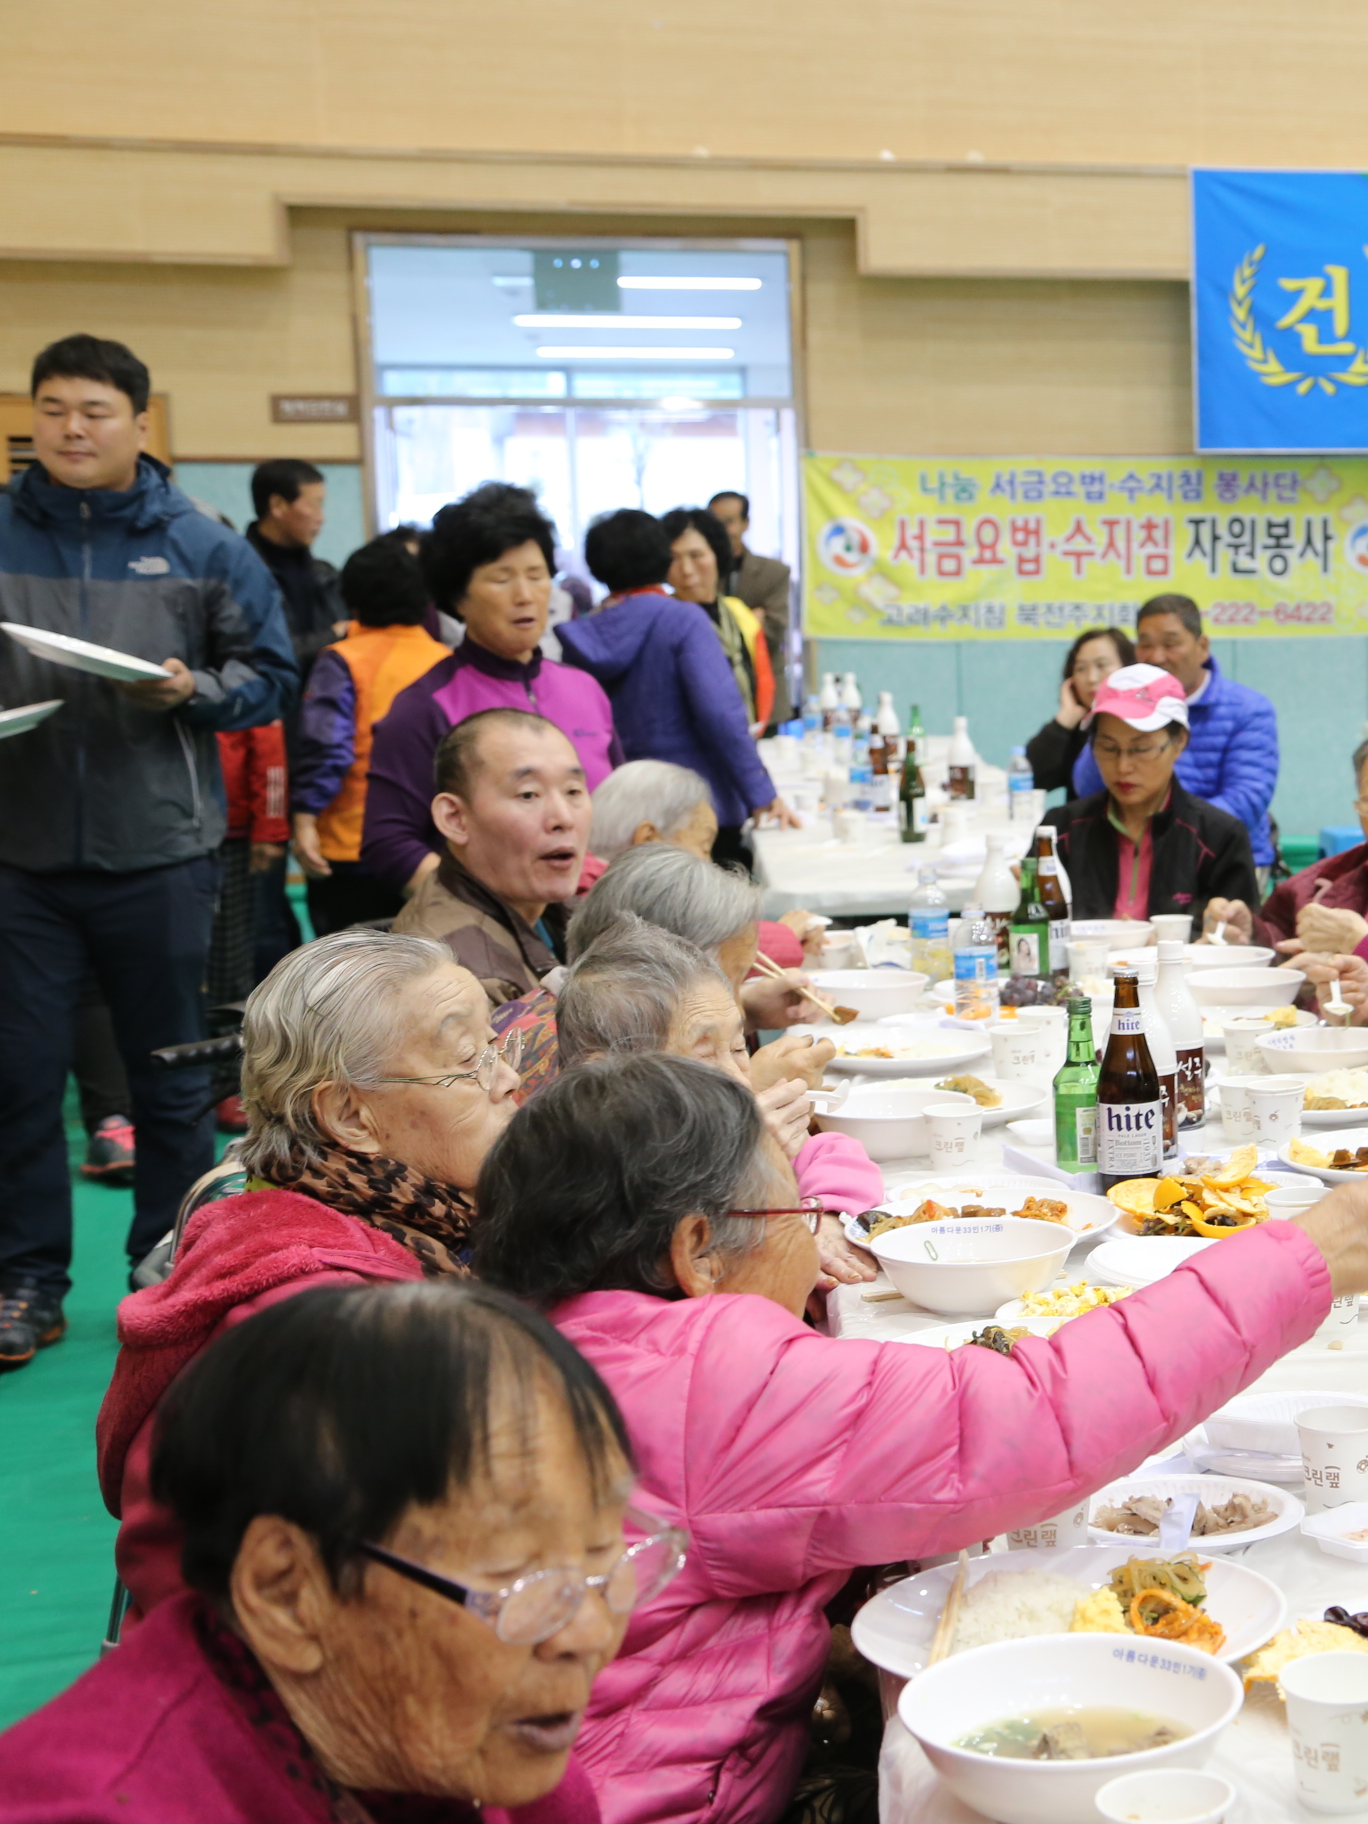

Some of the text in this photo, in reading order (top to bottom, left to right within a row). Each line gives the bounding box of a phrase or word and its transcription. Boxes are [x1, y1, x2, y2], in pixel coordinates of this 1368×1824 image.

[919, 470, 979, 501] 나눔
[1213, 469, 1300, 502] 봉사단
[1186, 515, 1334, 577] 자원봉사
[1117, 1019, 1141, 1031] hite
[1106, 1106, 1156, 1133] hite
